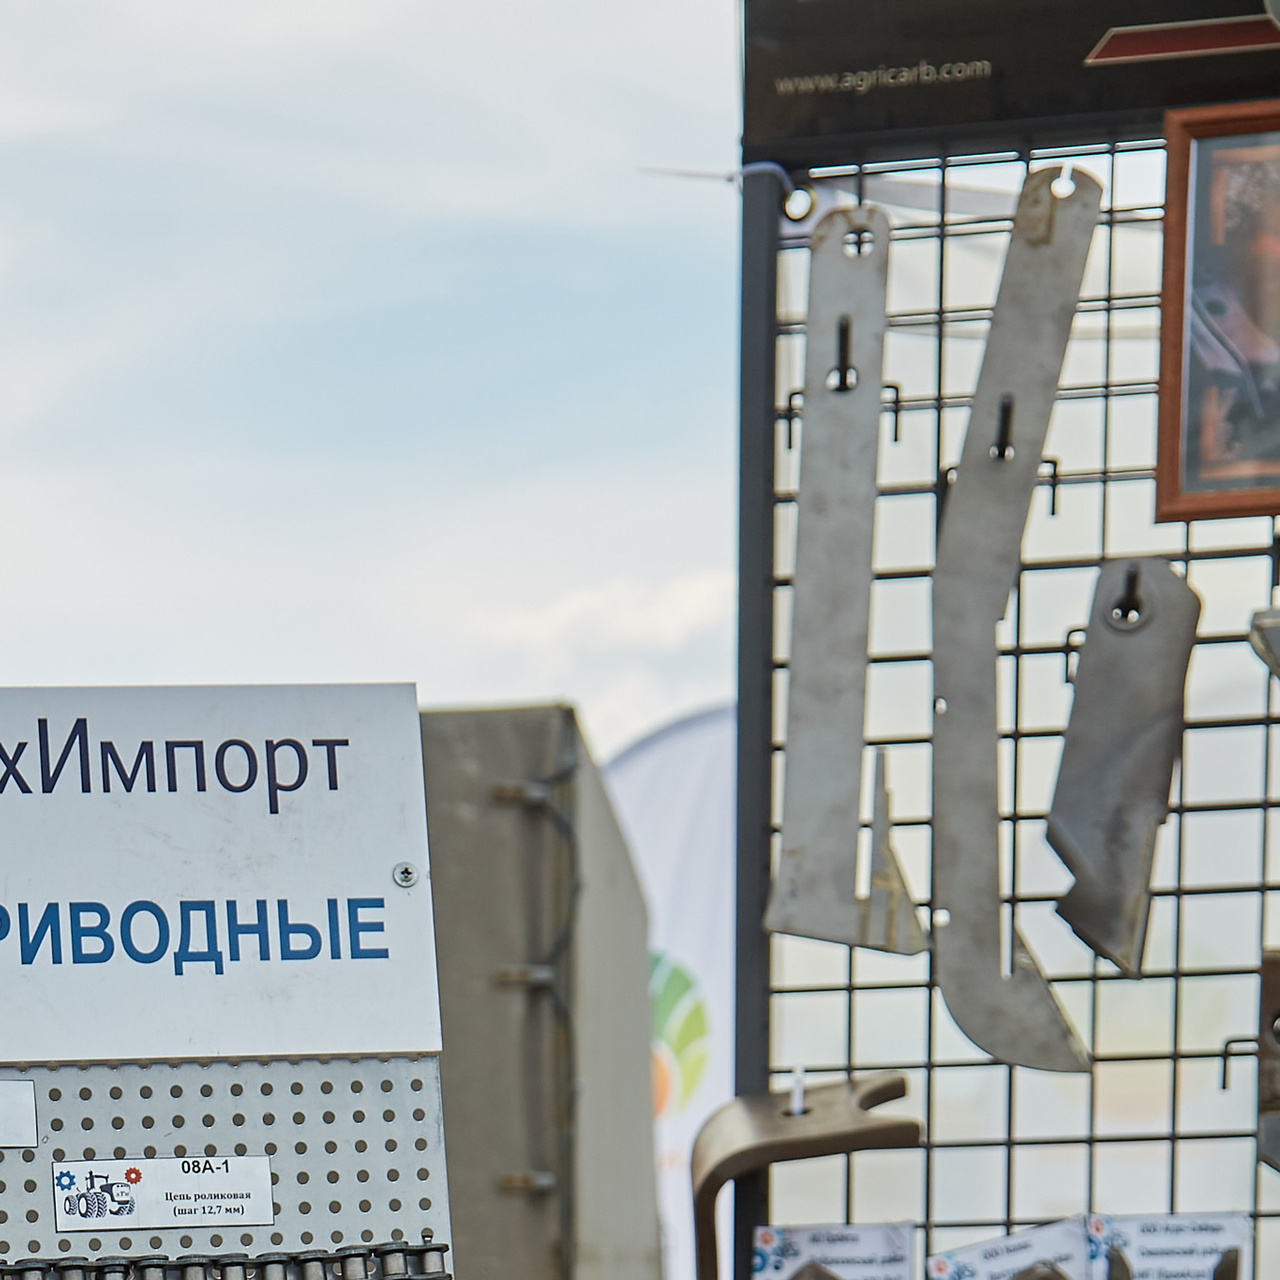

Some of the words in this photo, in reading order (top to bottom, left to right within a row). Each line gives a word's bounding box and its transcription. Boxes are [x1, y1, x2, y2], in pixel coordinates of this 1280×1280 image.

[773, 59, 992, 96] www.agricarb.com
[181, 1159, 229, 1174] 08A-1
[165, 1192, 192, 1202] Цепь
[194, 1192, 251, 1202] роликовая
[173, 1206, 199, 1217] (шаг
[202, 1205, 222, 1215] 12,7
[225, 1204, 244, 1216] мм)
